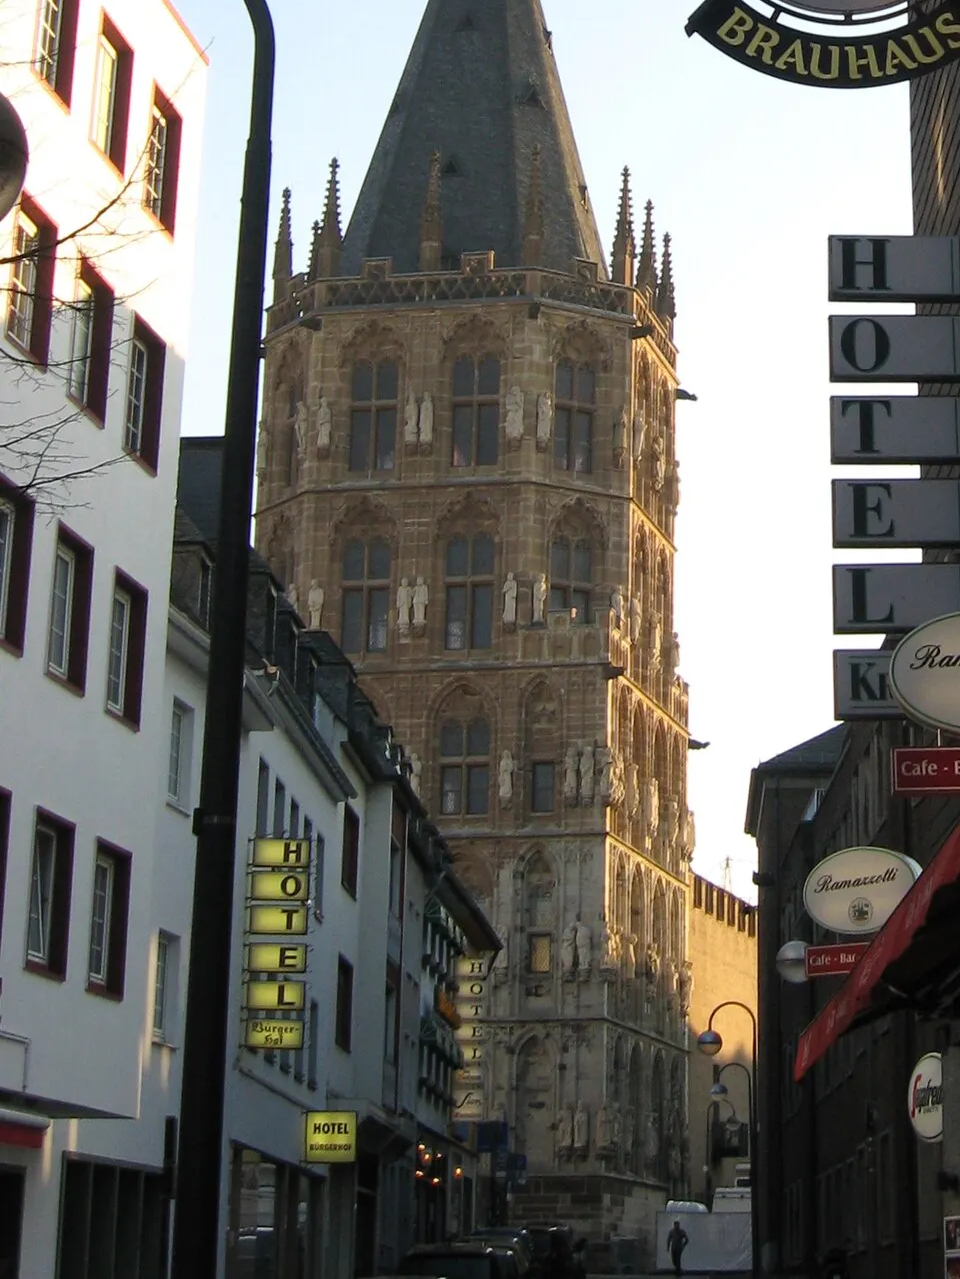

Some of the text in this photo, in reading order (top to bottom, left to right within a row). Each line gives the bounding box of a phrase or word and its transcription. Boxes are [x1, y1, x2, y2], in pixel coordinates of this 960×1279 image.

[836, 237, 895, 624] HOTEL
[901, 760, 938, 776] Cafe
[815, 868, 900, 893] Ramazzotti
[276, 841, 302, 1007] HOTEL
[810, 954, 831, 967] Cafe
[840, 953, 857, 964] Bar
[313, 1123, 349, 1135] HOTEL
